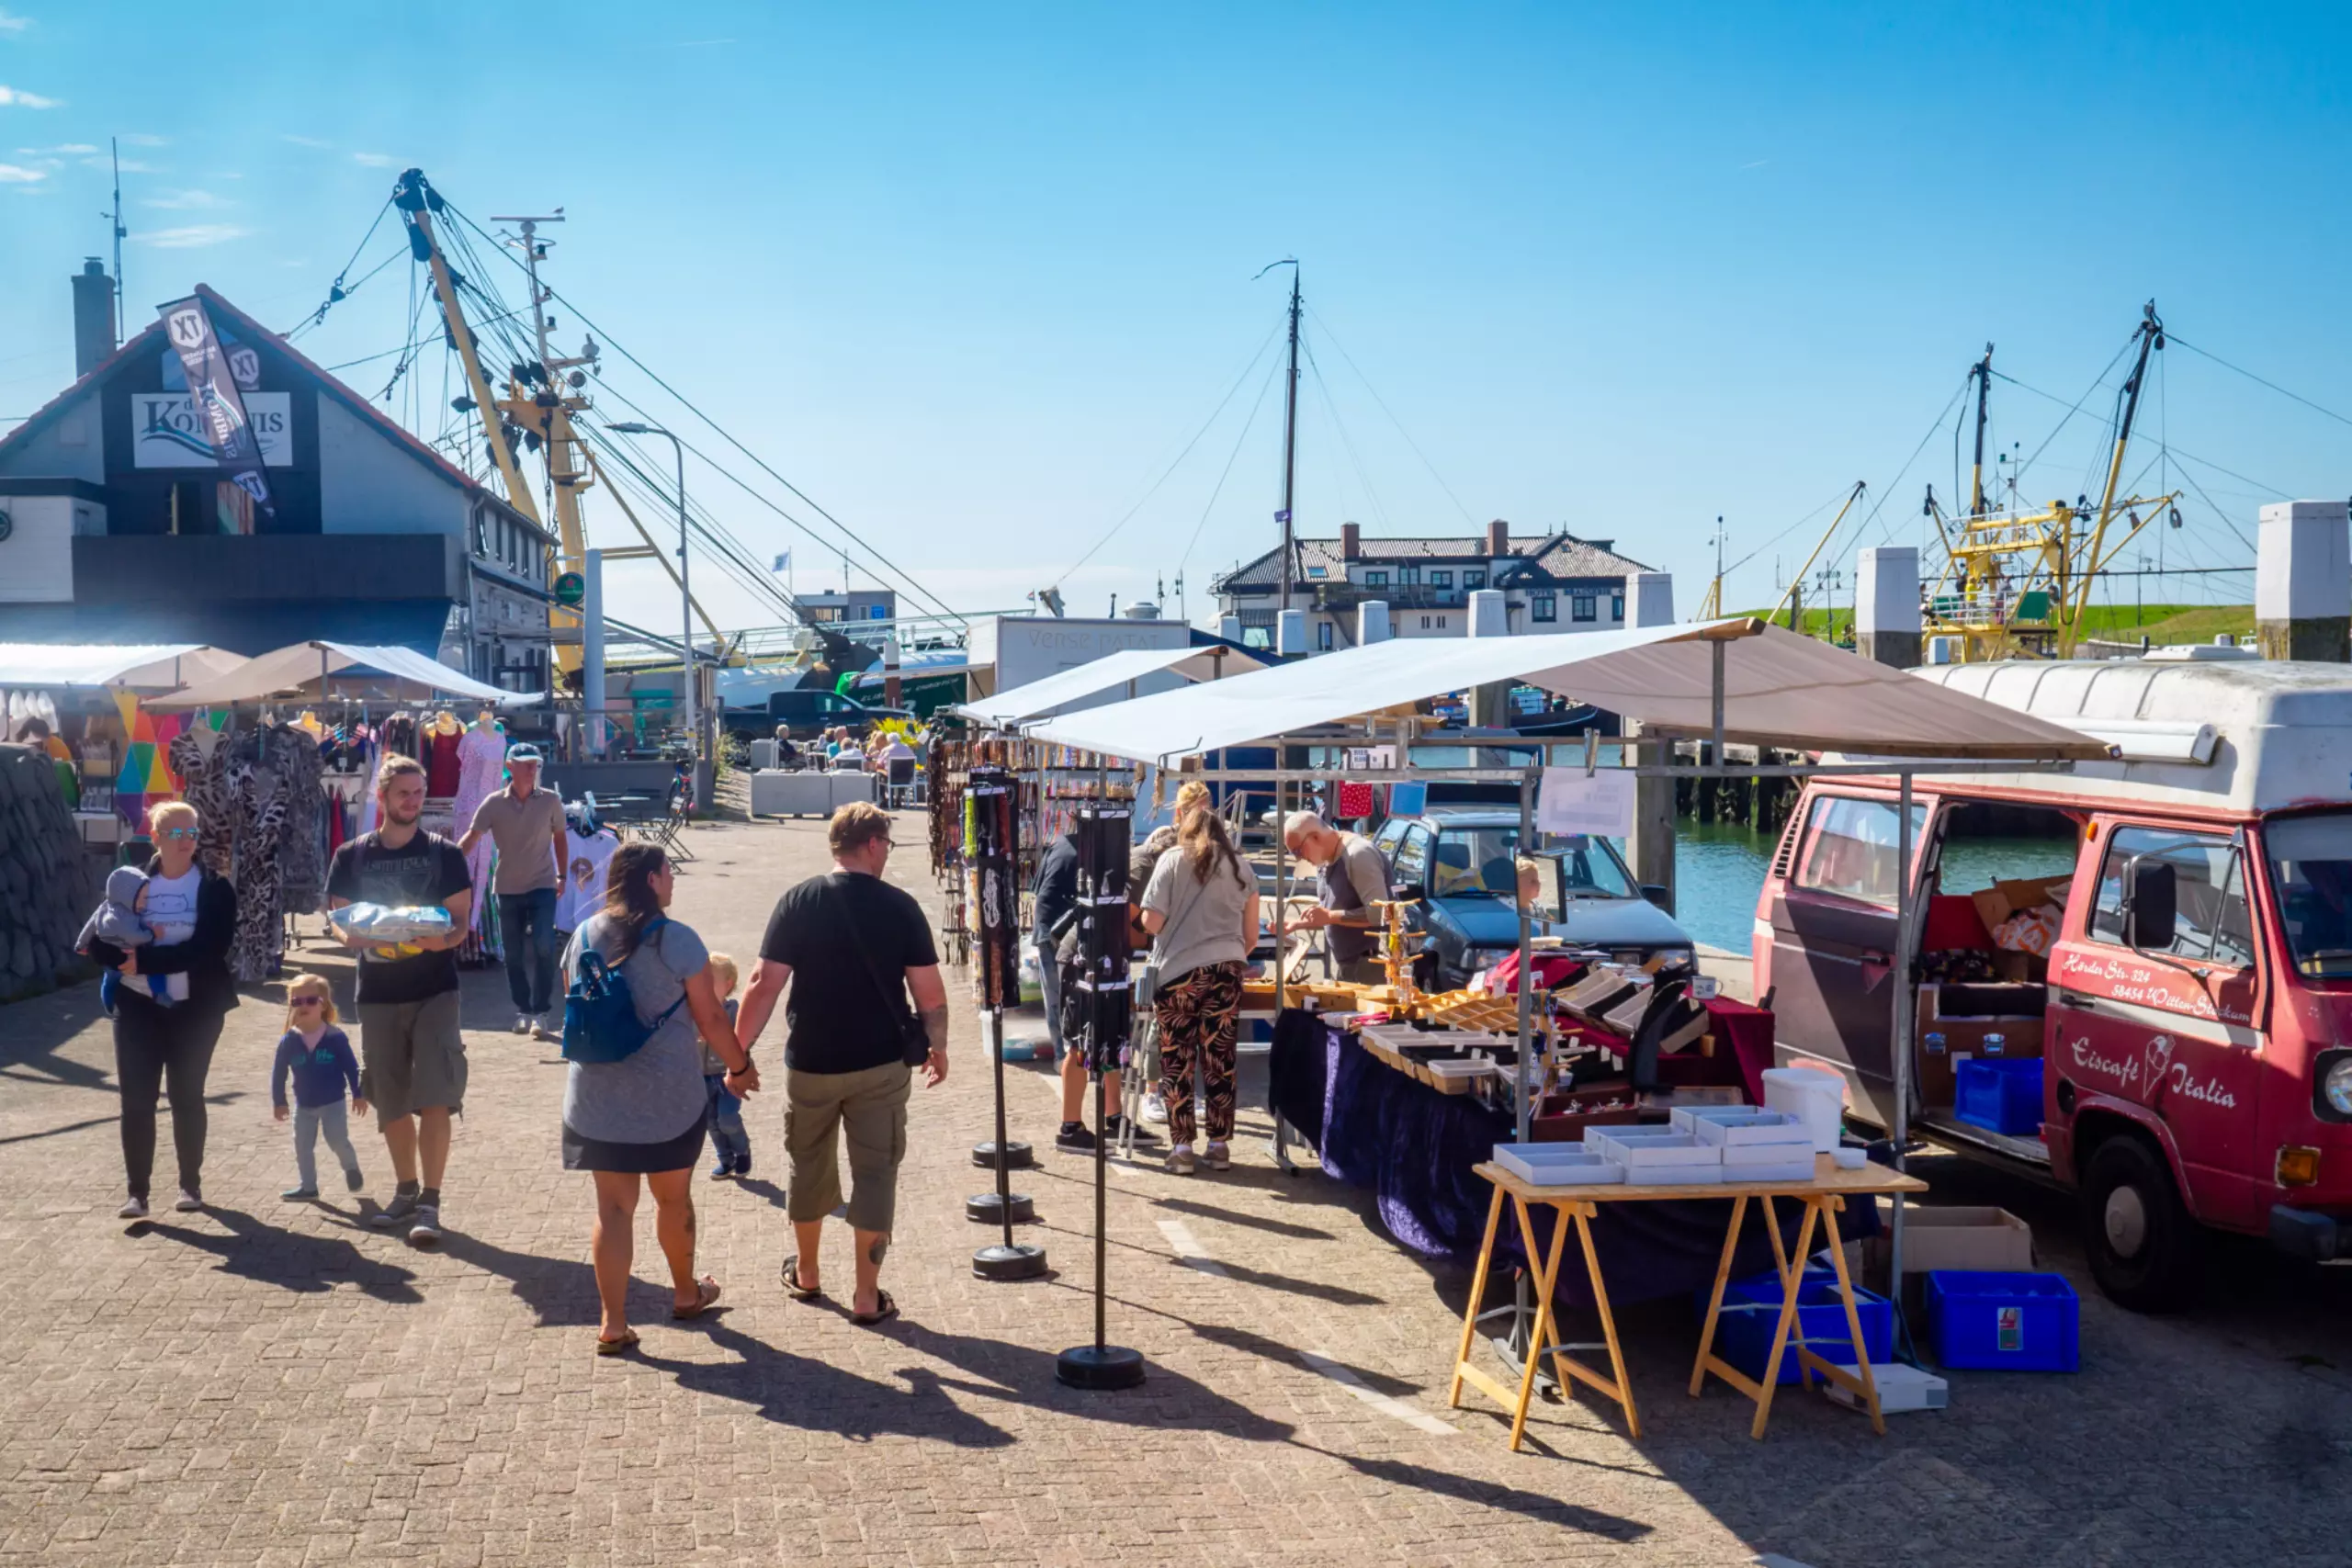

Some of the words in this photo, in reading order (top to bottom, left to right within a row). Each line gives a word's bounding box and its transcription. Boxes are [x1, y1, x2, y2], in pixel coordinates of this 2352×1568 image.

[2131, 969, 2151, 983] 324
[2071, 1037, 2140, 1088] Eiscafé
[2171, 1063, 2237, 1108] Italia
